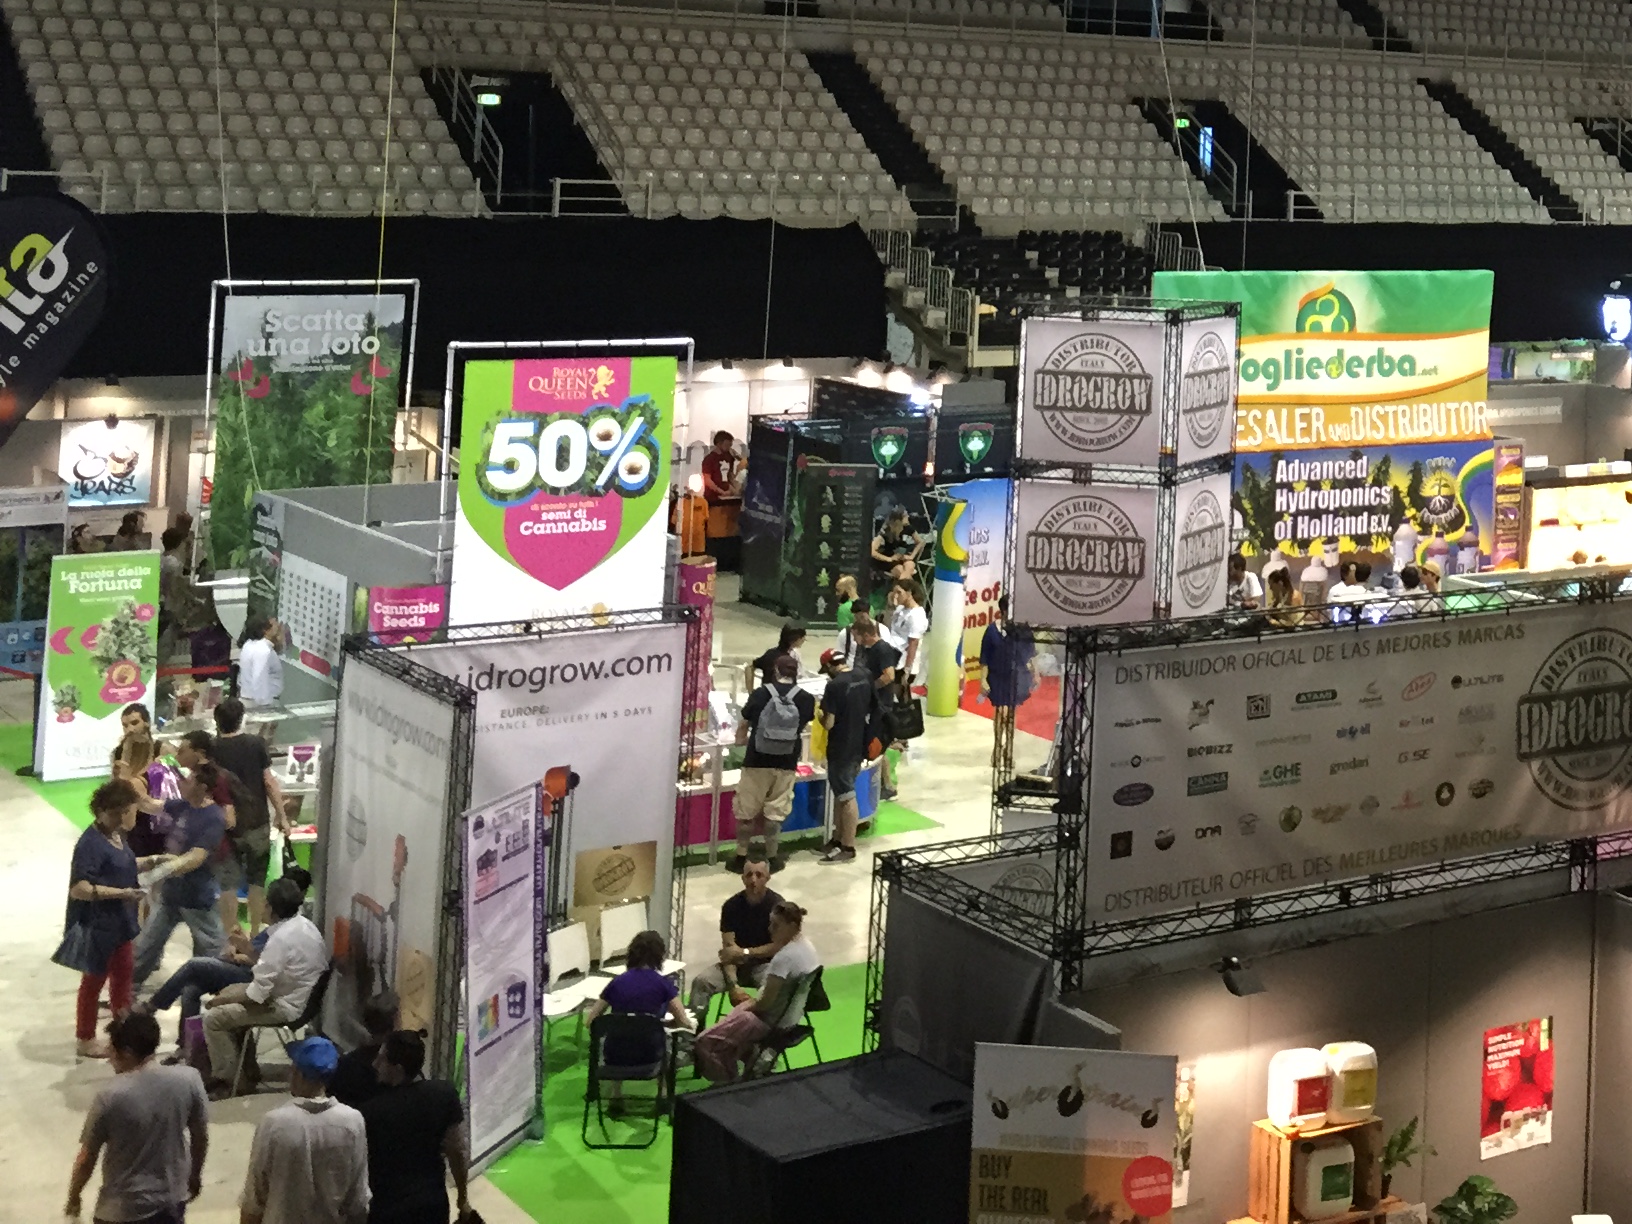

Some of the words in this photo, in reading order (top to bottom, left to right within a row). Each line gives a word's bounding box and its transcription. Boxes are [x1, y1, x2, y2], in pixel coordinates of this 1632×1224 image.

[23, 260, 99, 350] magazine
[265, 309, 365, 333] Scatta
[246, 335, 310, 356] una
[321, 331, 380, 356] foto
[1051, 337, 1137, 373] DISTRIBUTOR
[552, 367, 588, 377] ROYAL
[528, 376, 589, 396] QUEEN
[1034, 372, 1152, 411] IDROGROW
[1350, 401, 1487, 440] DISTRIBUTOR
[485, 416, 651, 491] 50%
[1275, 456, 1367, 482] Advanced
[1275, 485, 1391, 512] Hydroponics
[519, 517, 607, 536] Cannabis
[541, 509, 571, 521] semi
[573, 509, 587, 519] di
[1043, 499, 1130, 535] DISTRIBUTOR
[1274, 519, 1293, 540] of
[1296, 515, 1368, 539] Holland
[1370, 516, 1392, 533] B.V.
[1028, 535, 1145, 575] IDROGROW
[68, 578, 143, 595] Fortuna
[373, 601, 440, 615] Cannabis
[383, 615, 426, 628] Seeds
[1115, 655, 1237, 685] DISTRIBUIDOR
[1242, 647, 1308, 671] OFICIAL
[1313, 644, 1336, 663] DE
[1340, 640, 1371, 658] LAS
[1375, 633, 1452, 656] MEJORES
[1457, 622, 1526, 646] MARCAS
[1272, 761, 1303, 780] GHE
[1103, 871, 1225, 914] DISTRIBUTEUR
[1228, 862, 1298, 889] OFFICIEL
[1303, 855, 1334, 878] DES
[1338, 831, 1440, 871] MEILLEURES
[1442, 823, 1523, 855] MARQUES
[978, 1154, 1012, 1179] BUY
[978, 1183, 1006, 1210] THE
[1011, 1185, 1050, 1214] REAL
